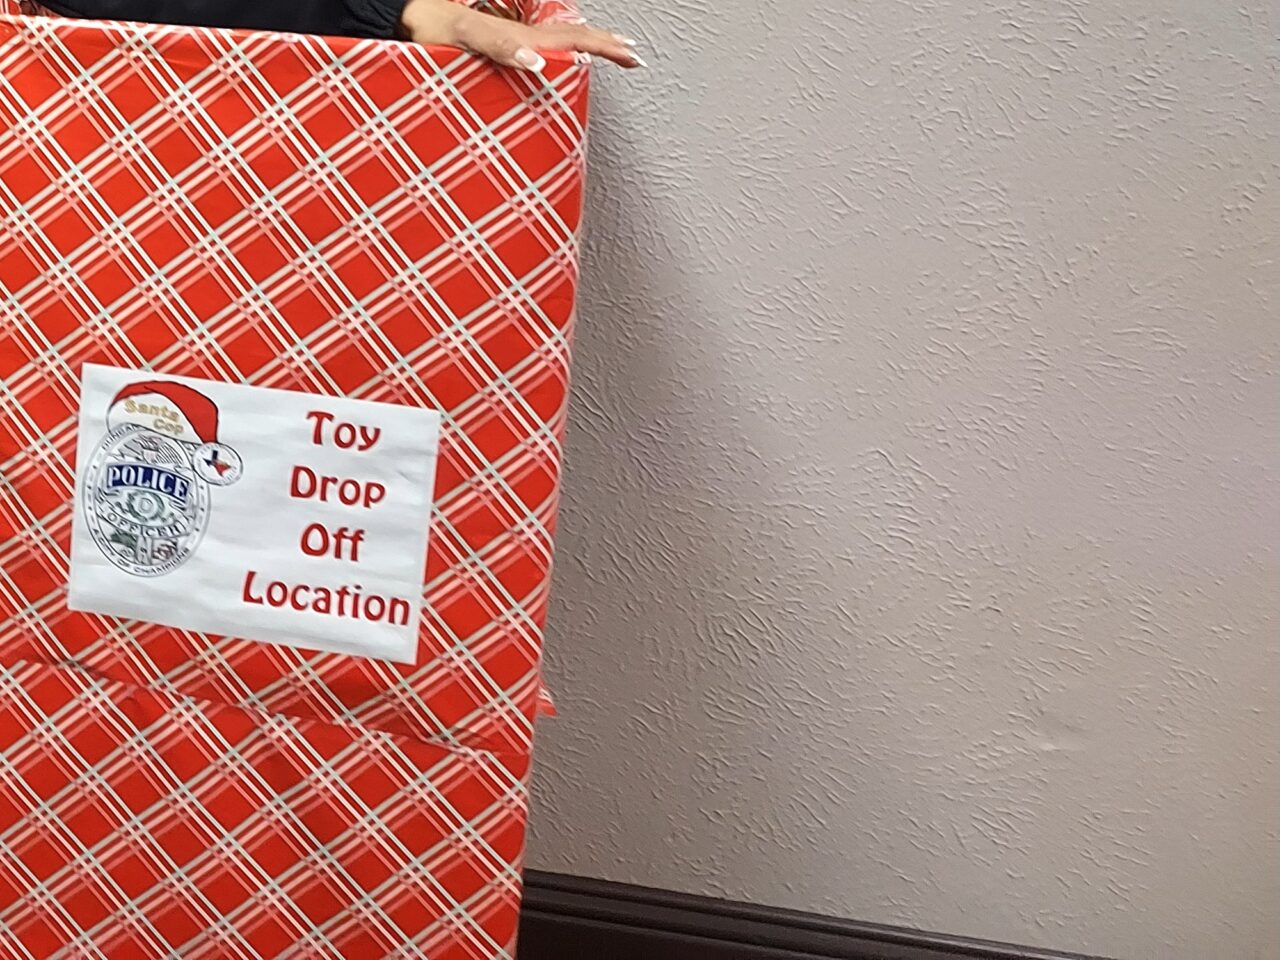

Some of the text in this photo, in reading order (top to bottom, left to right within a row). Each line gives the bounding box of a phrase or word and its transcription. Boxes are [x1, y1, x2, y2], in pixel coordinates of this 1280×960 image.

[124, 399, 179, 419] Santa
[153, 417, 184, 435] Cop
[306, 411, 381, 452] Toy
[108, 466, 189, 499] POLICE
[290, 465, 386, 509] Drop
[107, 511, 184, 539] OFFICER
[300, 522, 365, 562] Off
[242, 571, 410, 626] Location
